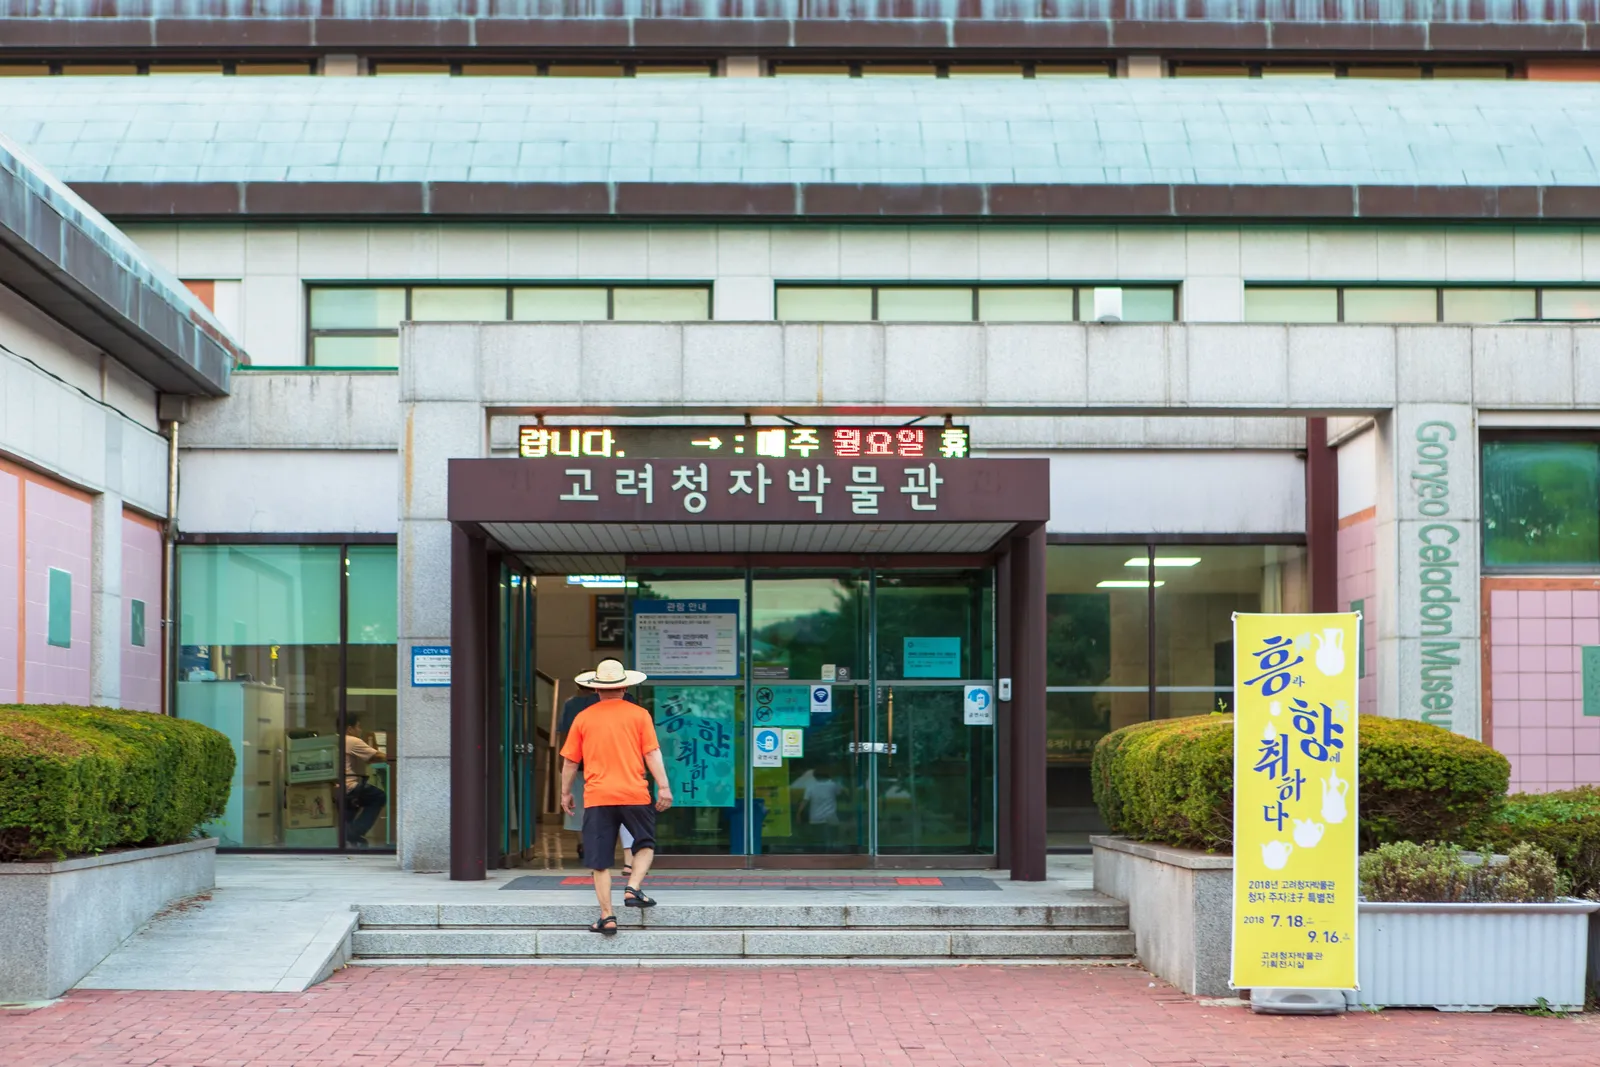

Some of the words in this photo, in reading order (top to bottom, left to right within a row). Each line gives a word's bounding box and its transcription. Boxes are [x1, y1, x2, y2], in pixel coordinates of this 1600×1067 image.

[833, 429, 924, 457] 월요일
[939, 429, 969, 458] 휴
[1411, 420, 1457, 517] Goryeo
[559, 462, 944, 514] 고려청자박물관
[1418, 523, 1460, 636] Celadon
[667, 602, 685, 612] 관람
[688, 602, 707, 612] 안내
[1420, 641, 1461, 732] Museu
[1288, 697, 1344, 763] 향에
[675, 737, 709, 799] 취하다
[1252, 733, 1307, 832] 취하다
[1248, 880, 1279, 890] 2018년
[1281, 880, 1335, 890] 고려청자박물관
[1248, 892, 1266, 904] 청자
[1307, 892, 1335, 904] 특별전
[1243, 916, 1265, 924] 2018
[1271, 914, 1283, 927] 7.
[1286, 915, 1306, 927] 18.
[1307, 930, 1319, 943] 9.
[1323, 931, 1342, 944] 16.
[1261, 951, 1324, 960] 고려청자박물관
[1261, 961, 1305, 969] 기획전시실
